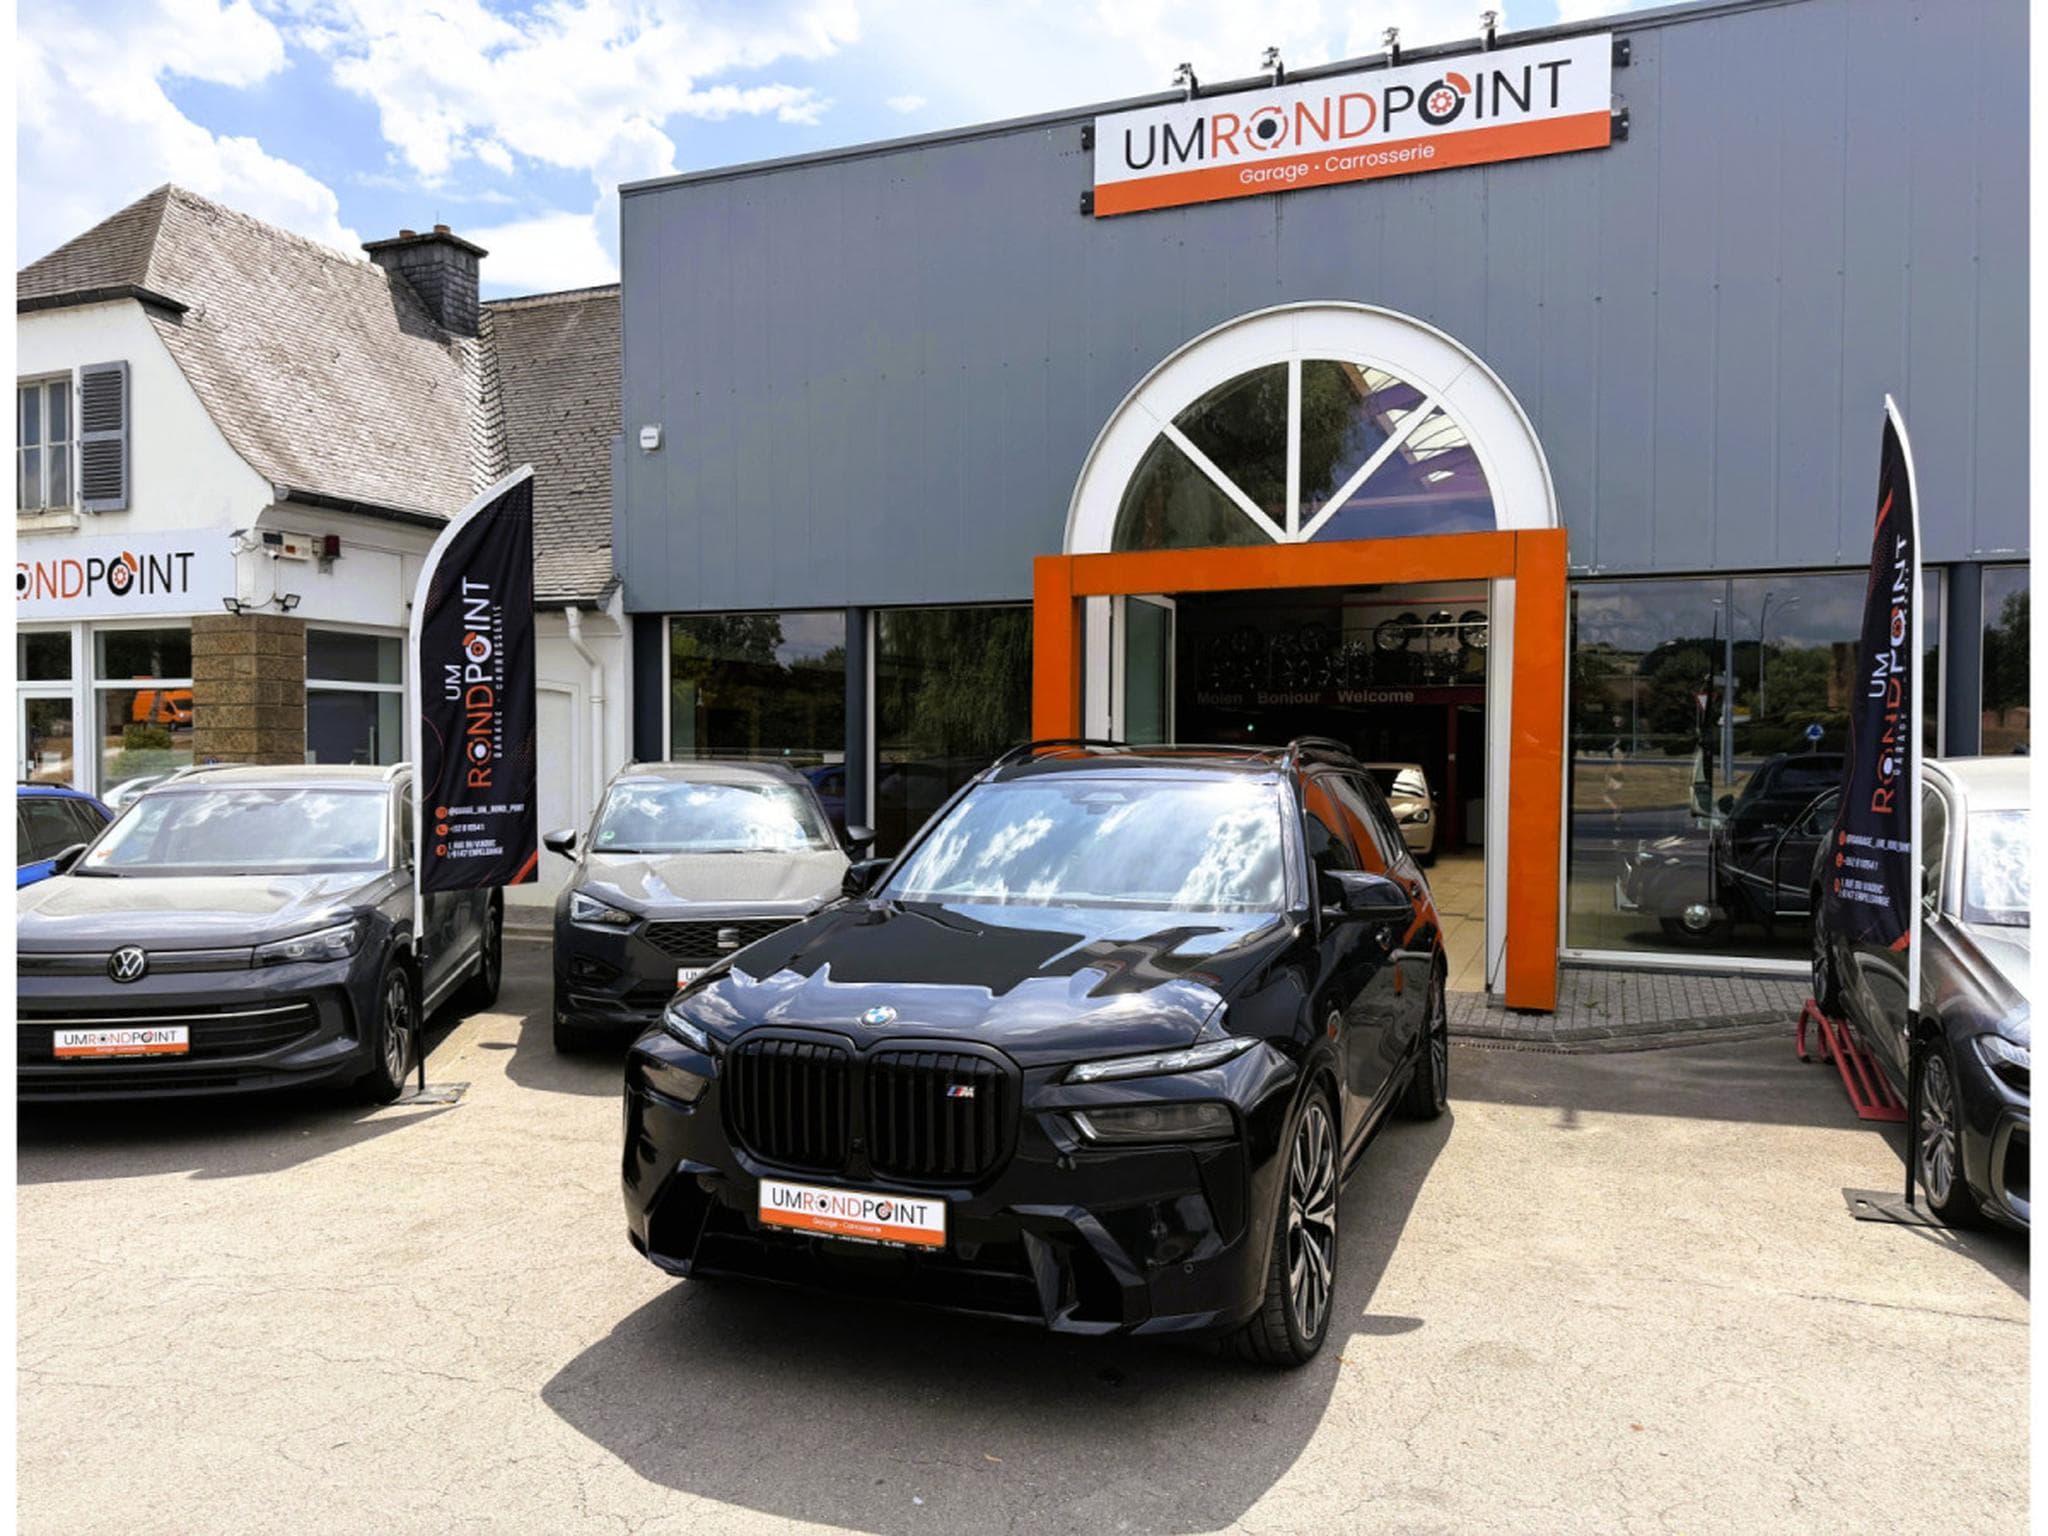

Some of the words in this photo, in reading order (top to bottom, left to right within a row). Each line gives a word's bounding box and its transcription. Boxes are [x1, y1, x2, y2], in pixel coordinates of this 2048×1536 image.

[1124, 59, 1572, 169] UMRONDPOINT
[1240, 161, 1309, 185] Garage
[1325, 143, 1435, 173] Carrosserie
[444, 664, 462, 700] UM
[462, 576, 494, 788] RONDPOINT
[1869, 652, 1890, 697] UM
[1337, 690, 1414, 704] Welcome
[772, 1187, 928, 1225] UMRONDPOINT
